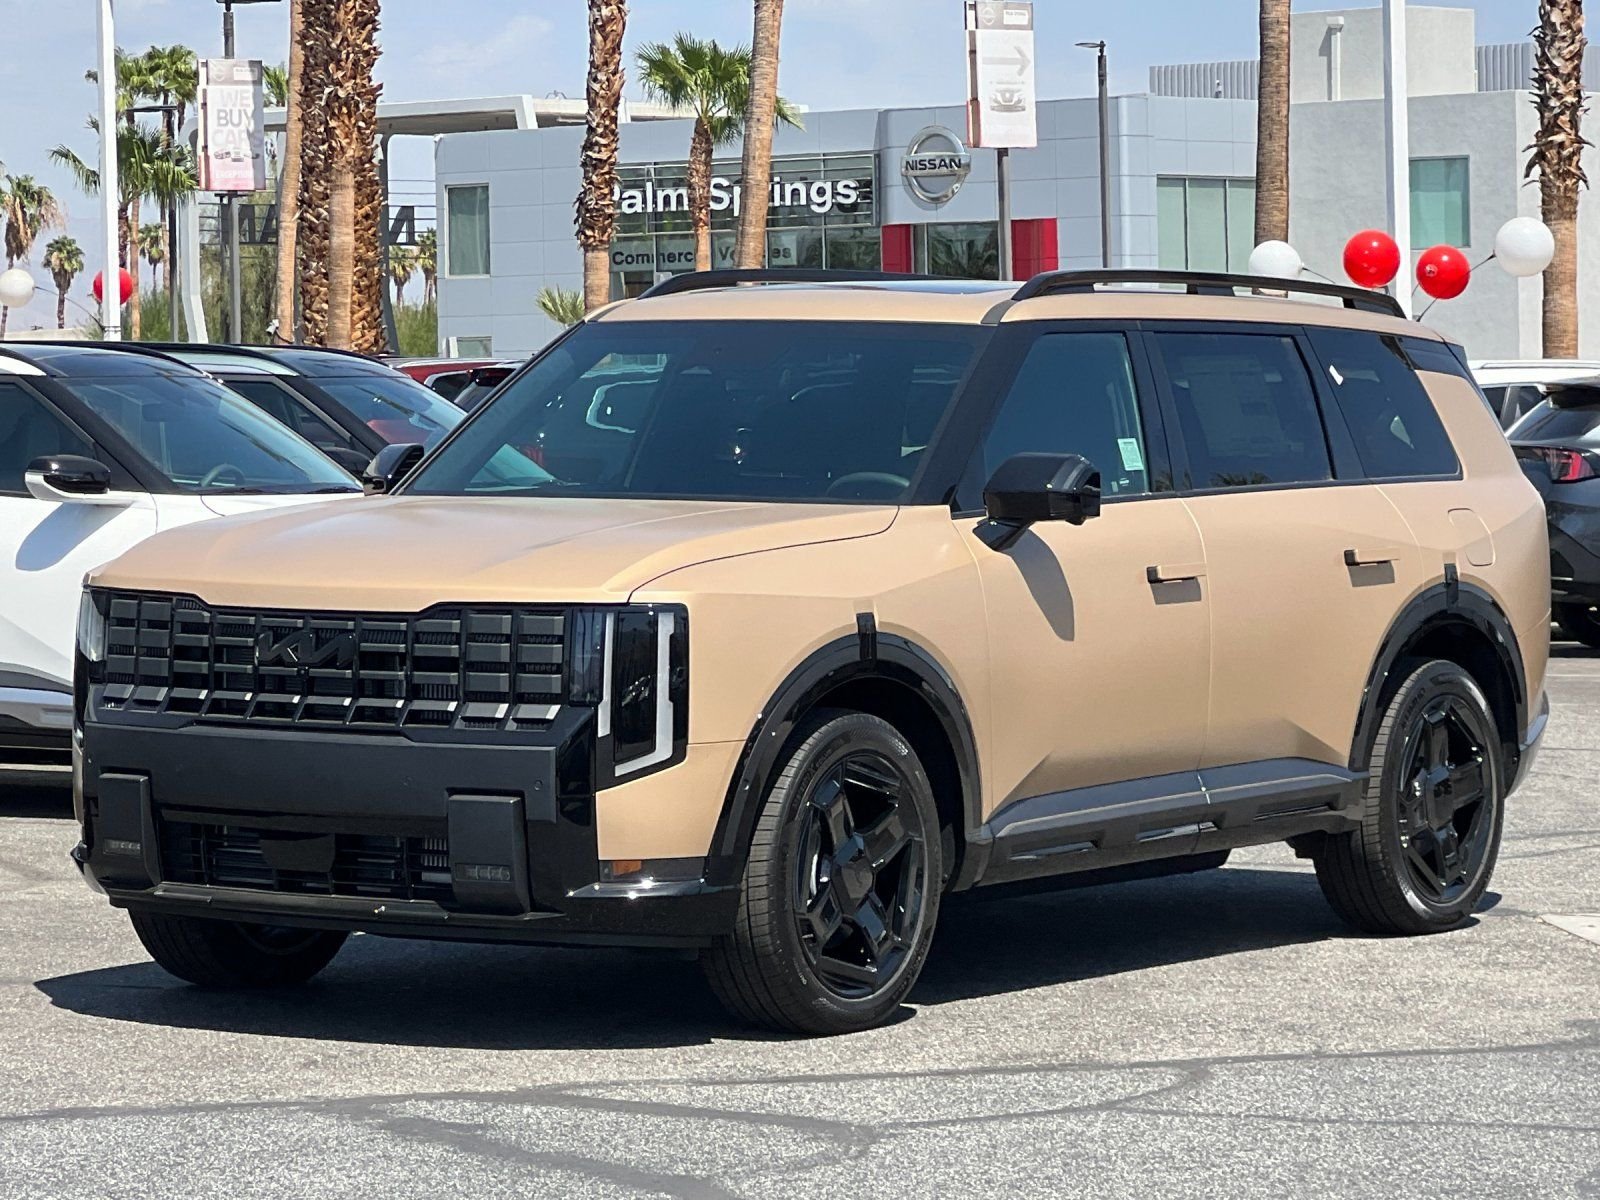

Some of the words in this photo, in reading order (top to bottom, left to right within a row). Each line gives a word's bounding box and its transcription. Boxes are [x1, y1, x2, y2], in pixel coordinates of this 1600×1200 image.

[219, 89, 251, 108] WE
[216, 108, 254, 128] BUY
[905, 158, 962, 171] NISSAN
[709, 176, 859, 217] Sings
[612, 250, 694, 266] Commerc
